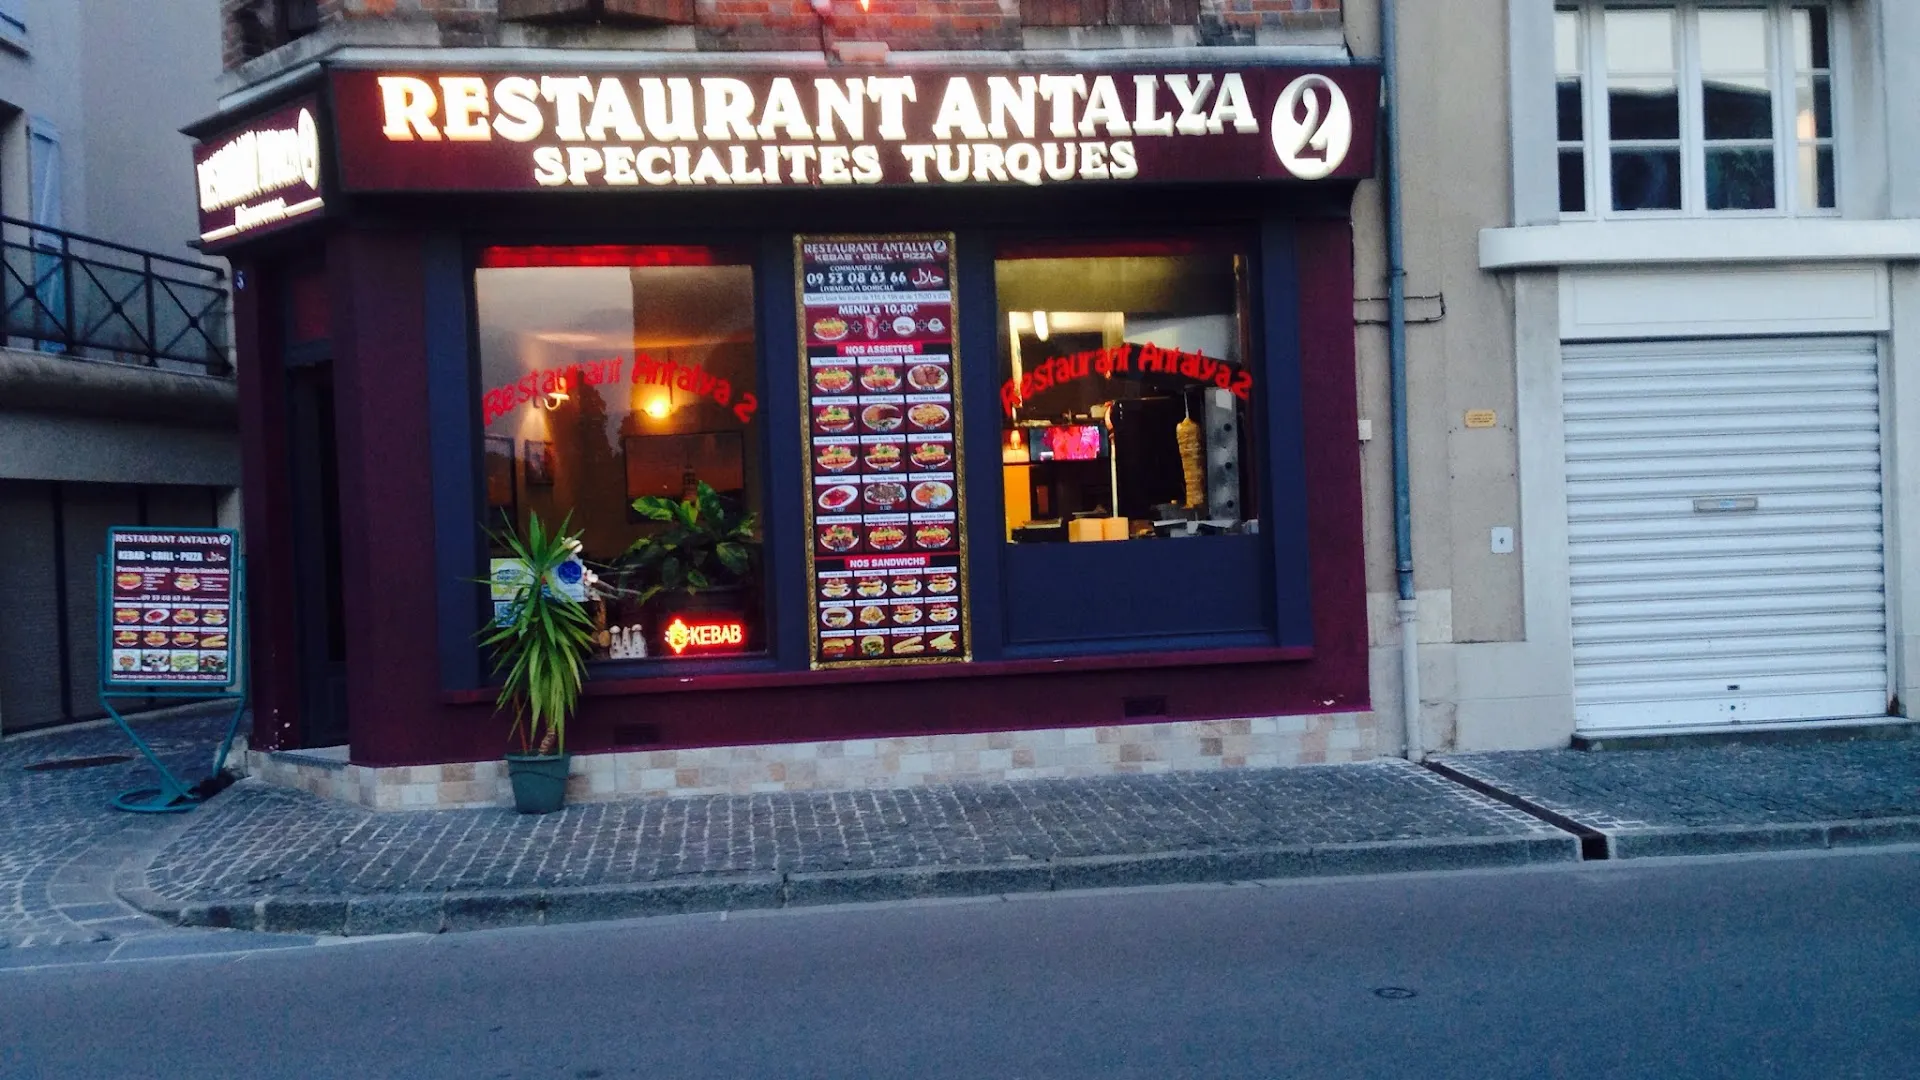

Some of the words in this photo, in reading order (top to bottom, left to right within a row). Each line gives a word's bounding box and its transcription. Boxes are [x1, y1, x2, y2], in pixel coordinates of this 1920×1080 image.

[377, 75, 917, 141] RESTAURANT
[931, 73, 1259, 139] ANTALYA
[532, 145, 883, 187] SPECIALITES
[900, 140, 1139, 186] TURQUES
[804, 243, 879, 254] RESTAURANT
[881, 242, 933, 252] ANTALYA
[814, 253, 853, 261] KEBAB
[902, 252, 934, 260] PIZZA
[806, 272, 824, 284] 09
[828, 272, 844, 283] 53
[847, 272, 866, 283] 08
[890, 271, 907, 282] 66
[838, 304, 871, 315] MENU
[845, 345, 866, 354] NOS
[867, 344, 914, 354] ASSIETTES
[1000, 343, 1133, 417] Restaurant
[1137, 341, 1233, 392] Antalya
[1231, 370, 1254, 401] 2
[482, 356, 625, 426] Restaurant
[631, 353, 732, 406] Antalya
[732, 392, 758, 423] 2
[115, 534, 175, 544] RESTAURANT
[177, 535, 220, 544] ANTALYA
[849, 559, 870, 568] NOS
[871, 557, 926, 567] SANDWICHS
[689, 623, 743, 646] KEBAB
